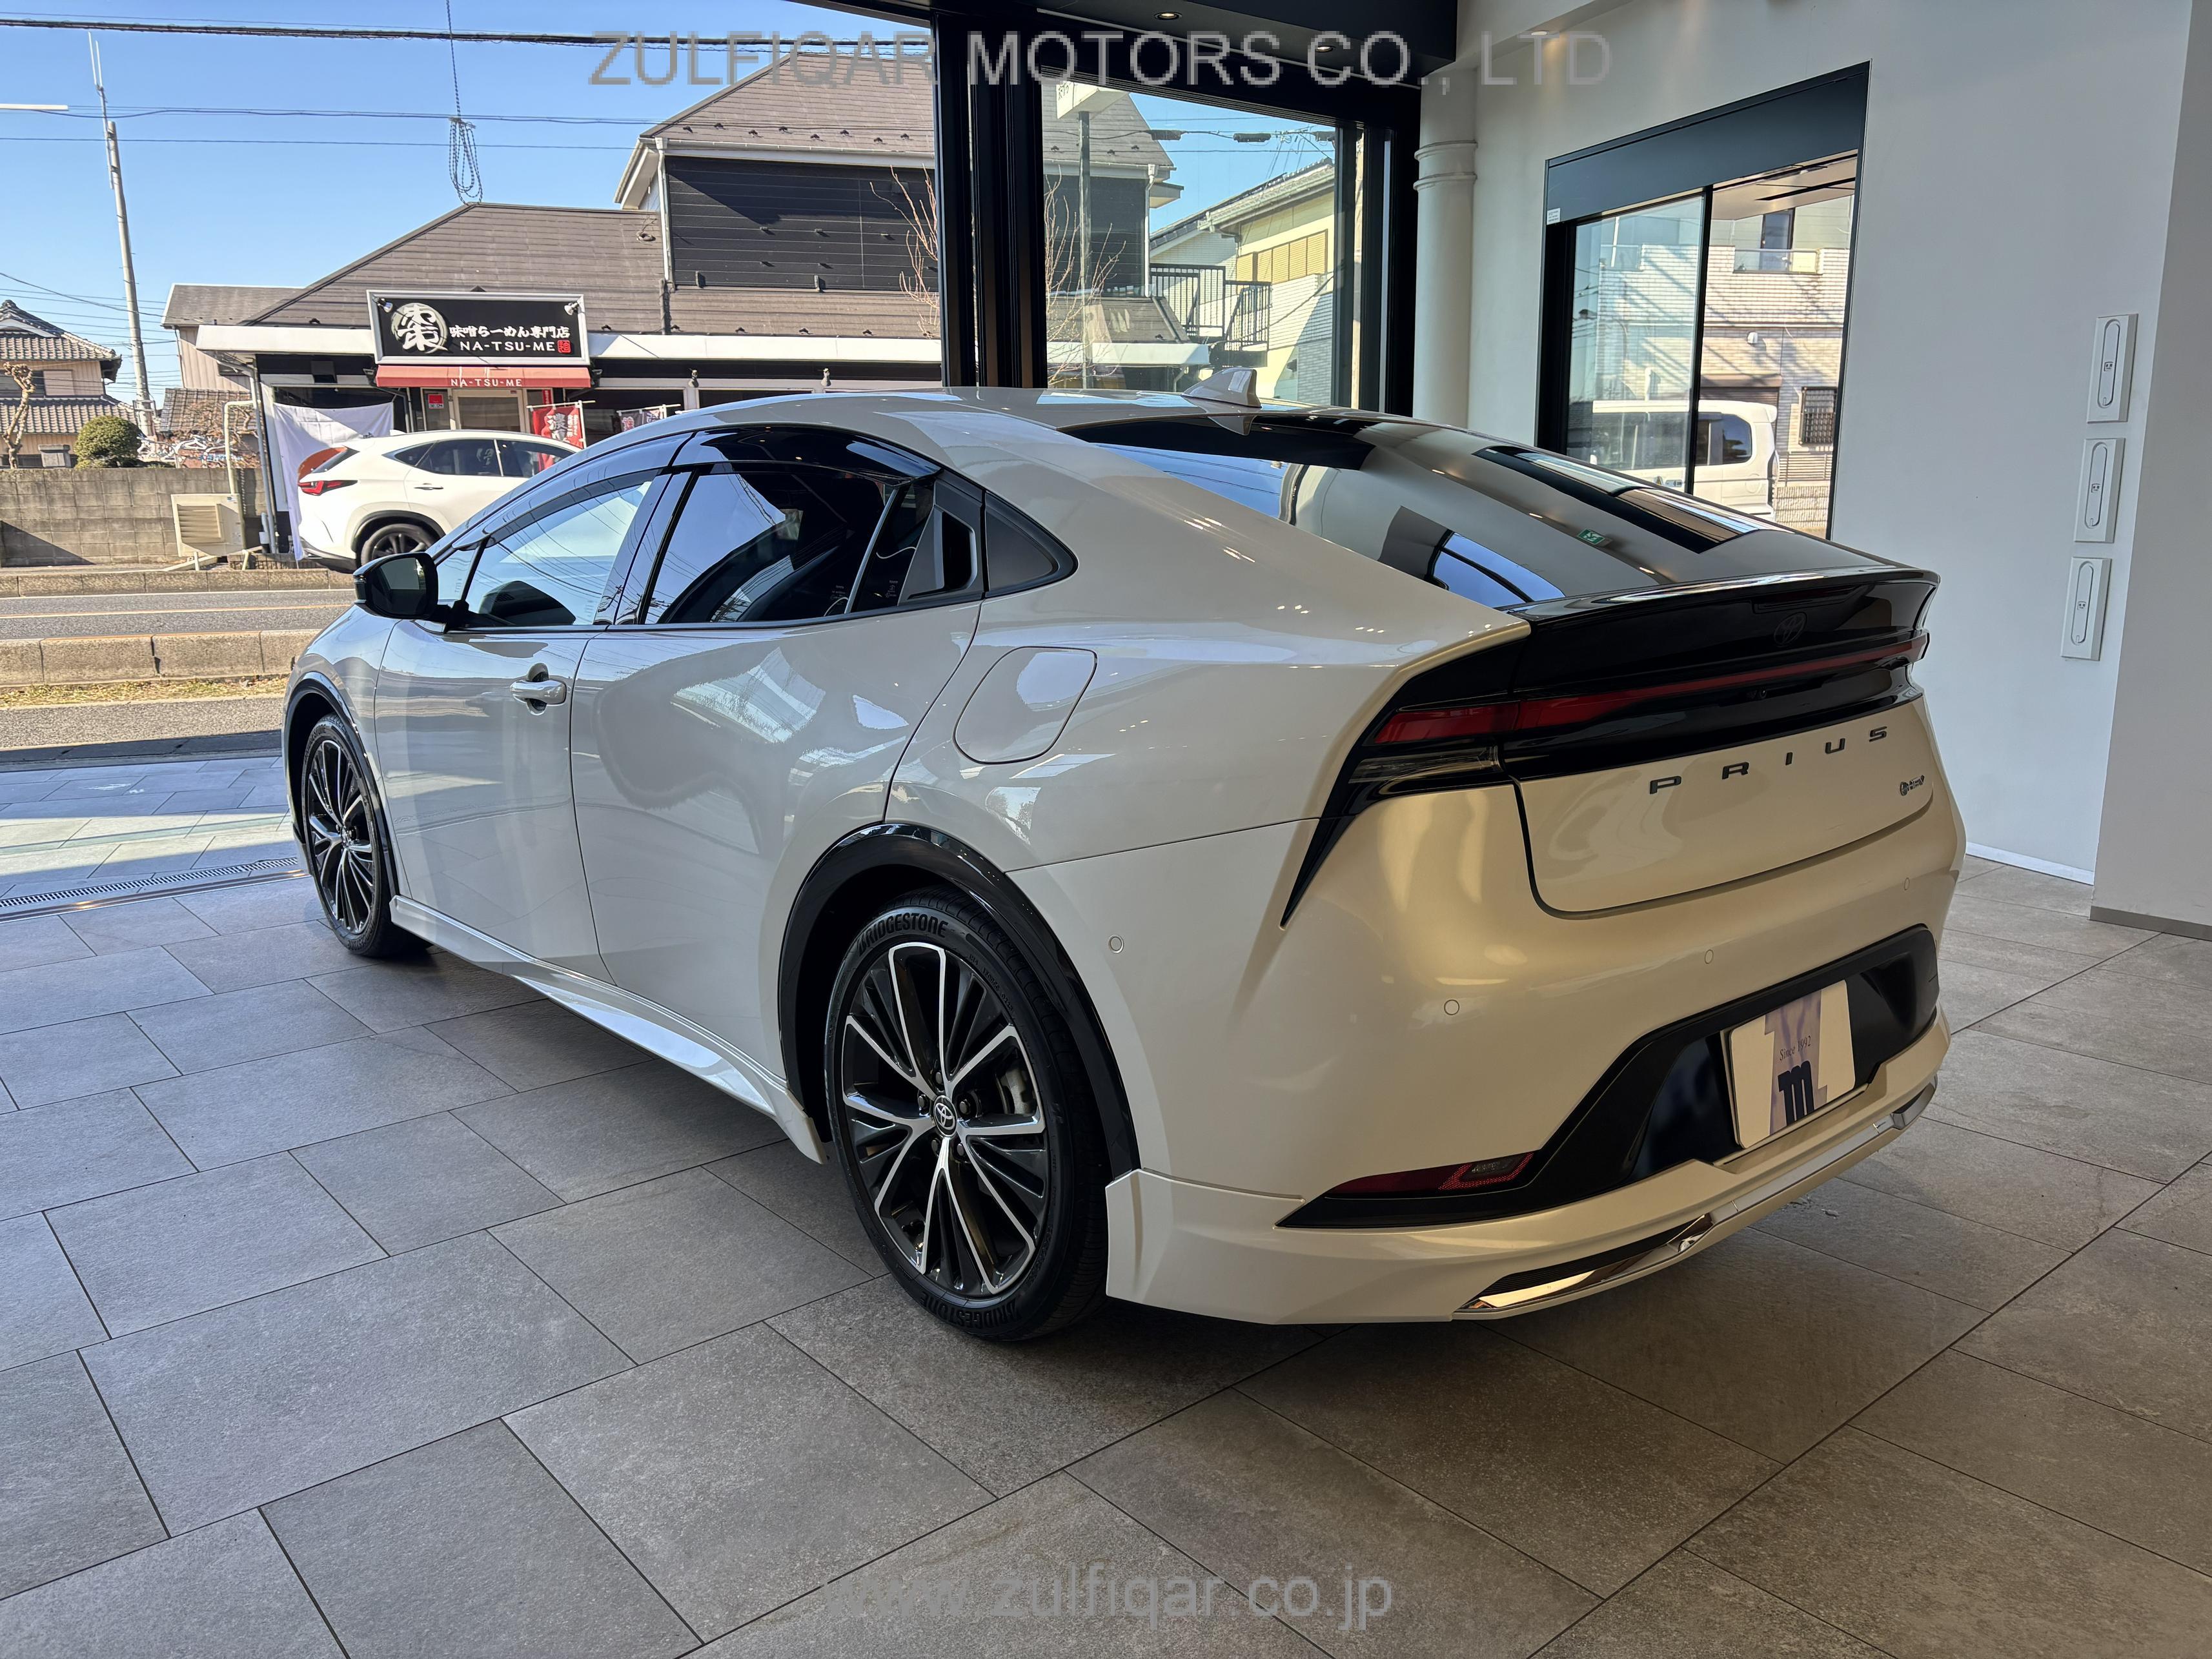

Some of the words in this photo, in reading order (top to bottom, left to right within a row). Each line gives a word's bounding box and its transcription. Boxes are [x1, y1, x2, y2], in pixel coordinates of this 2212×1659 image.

[449, 325, 571, 339] 味噌らーめん専門店
[460, 341, 555, 351] NA-TSU-ME
[451, 378, 522, 387] NA-TSU-ME
[1649, 726, 1888, 795] PRIUS
[857, 912, 949, 957] BRIDGESTONE
[1780, 1045, 1796, 1061] Since
[1798, 1035, 1811, 1052] 1992
